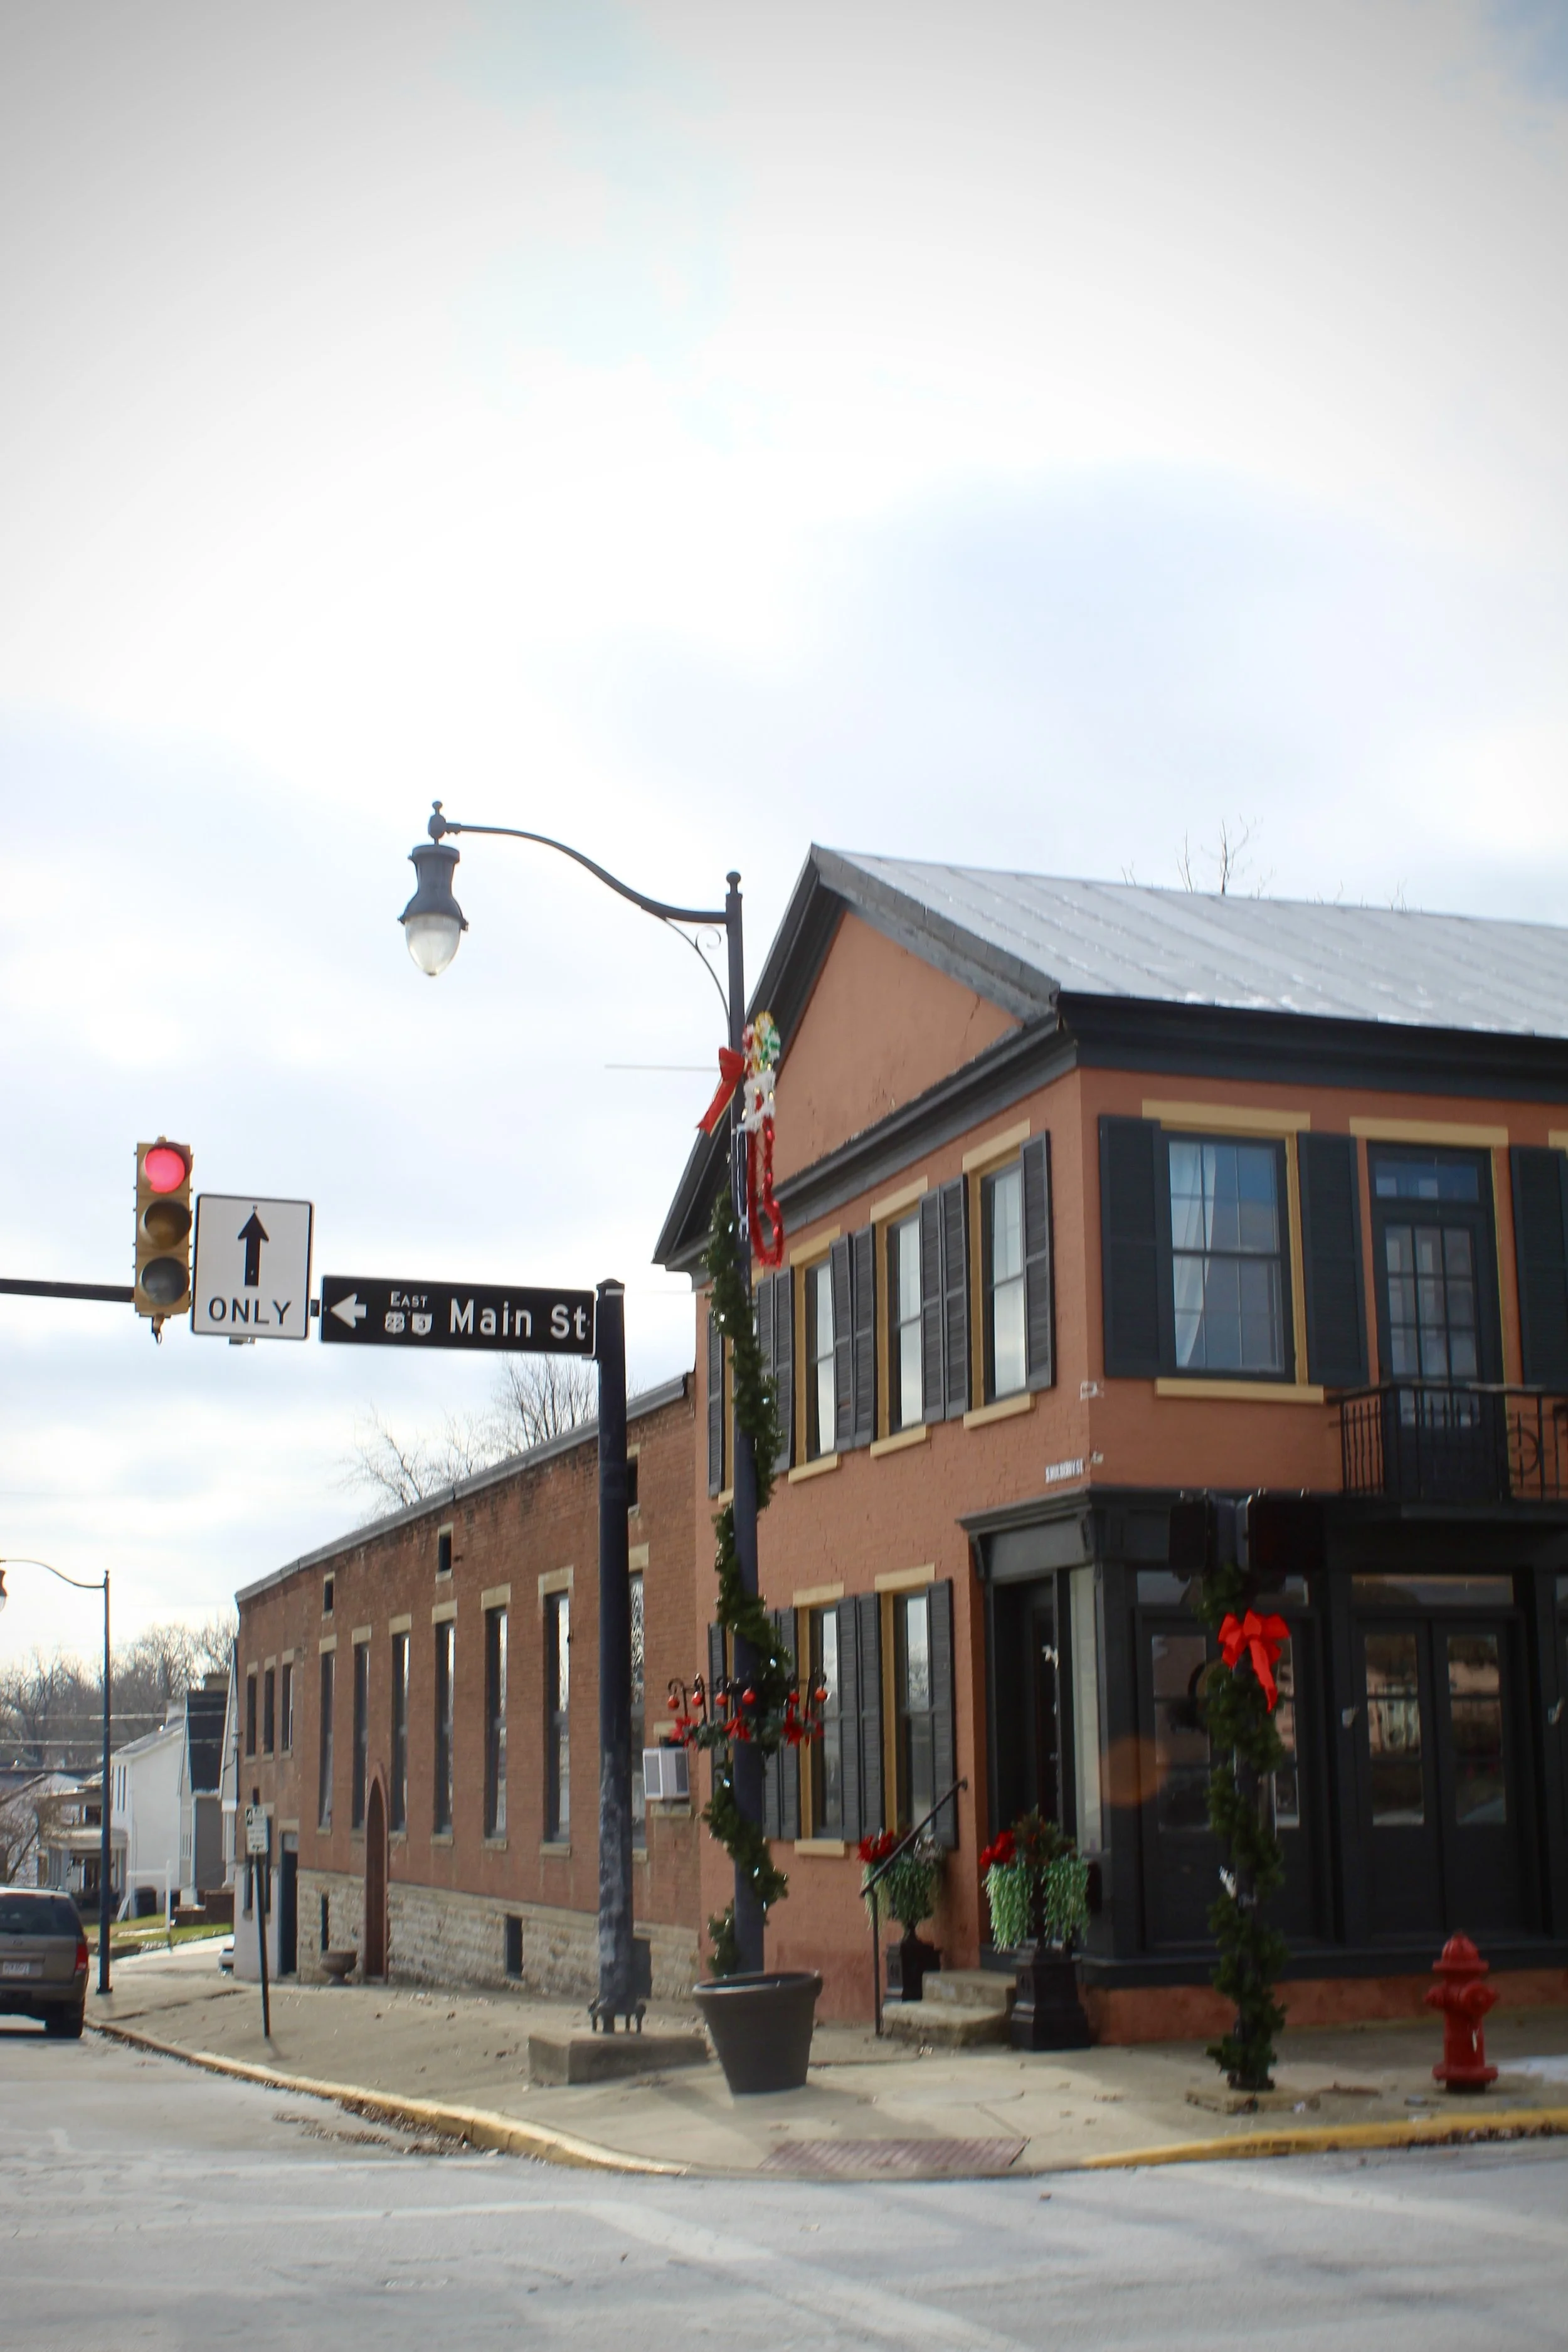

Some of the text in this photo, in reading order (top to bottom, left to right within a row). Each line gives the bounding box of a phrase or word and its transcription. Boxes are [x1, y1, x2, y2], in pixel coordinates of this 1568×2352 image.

[209, 1296, 292, 1325] ONLY
[450, 1297, 586, 1341] Main St
